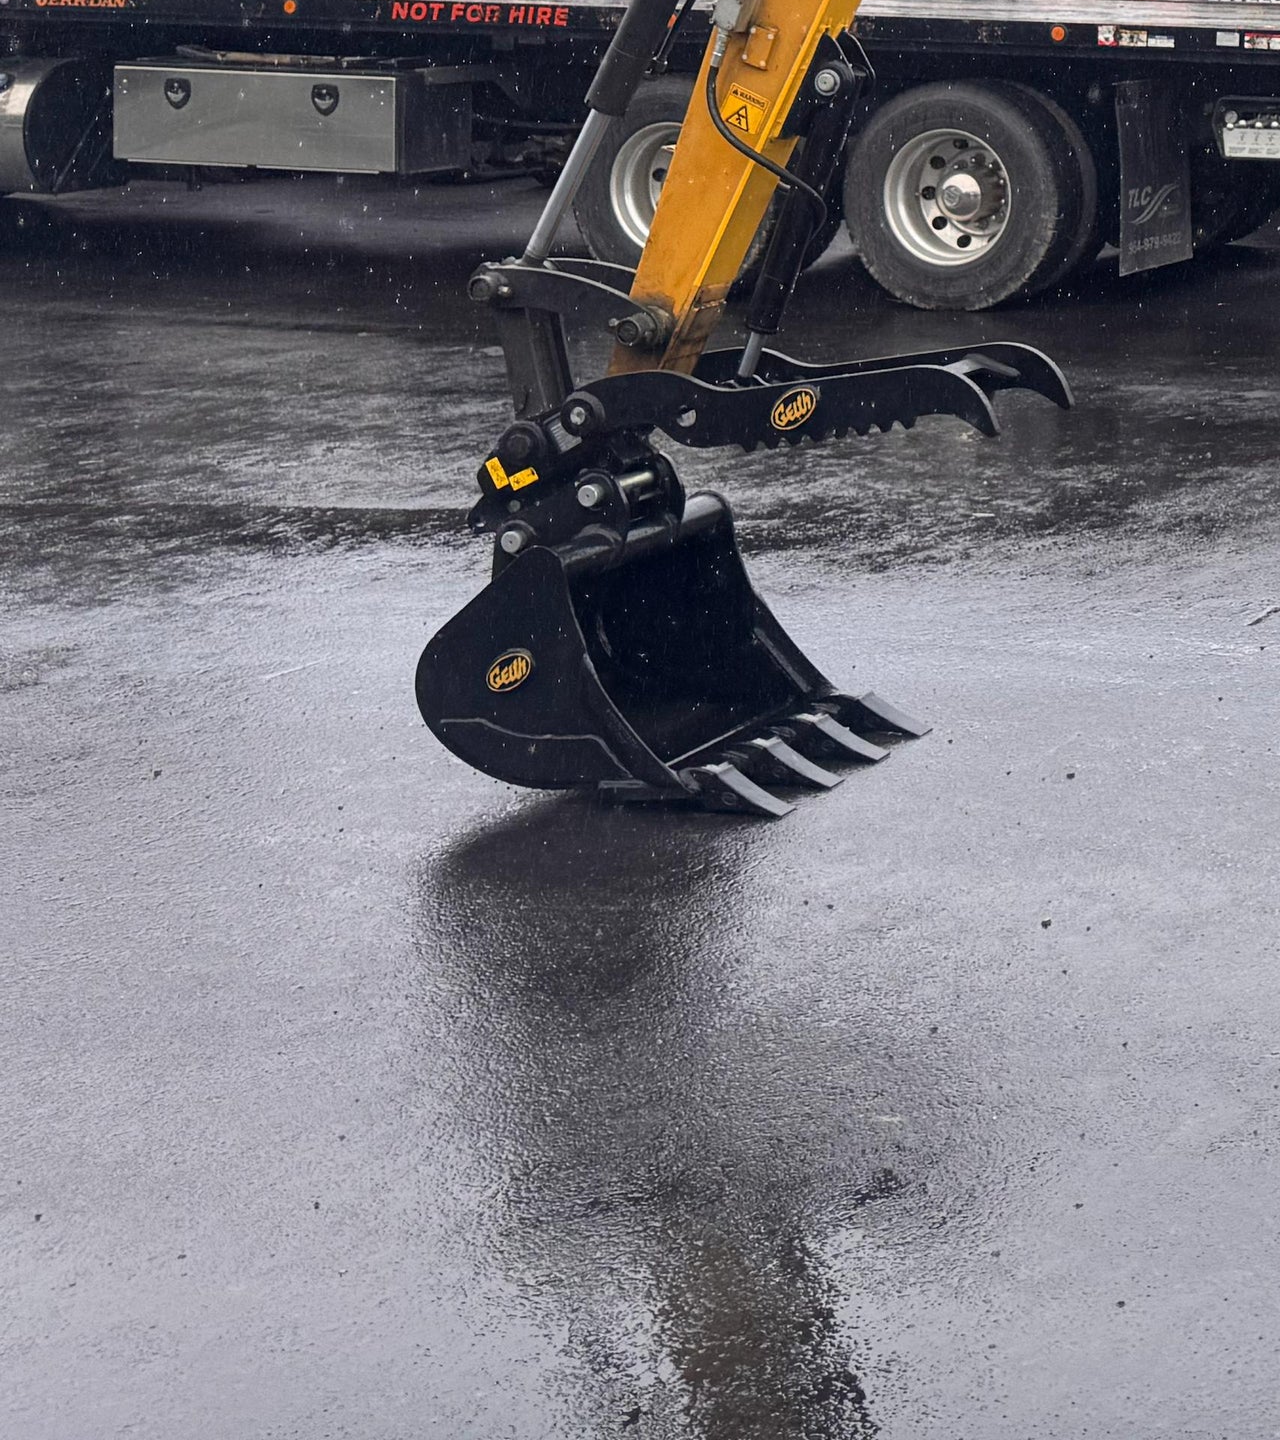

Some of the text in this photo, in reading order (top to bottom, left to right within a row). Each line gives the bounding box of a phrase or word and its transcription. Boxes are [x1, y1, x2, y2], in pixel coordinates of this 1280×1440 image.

[391, 2, 570, 27] NOT FOR HIRE
[1128, 186, 1153, 209] TLC
